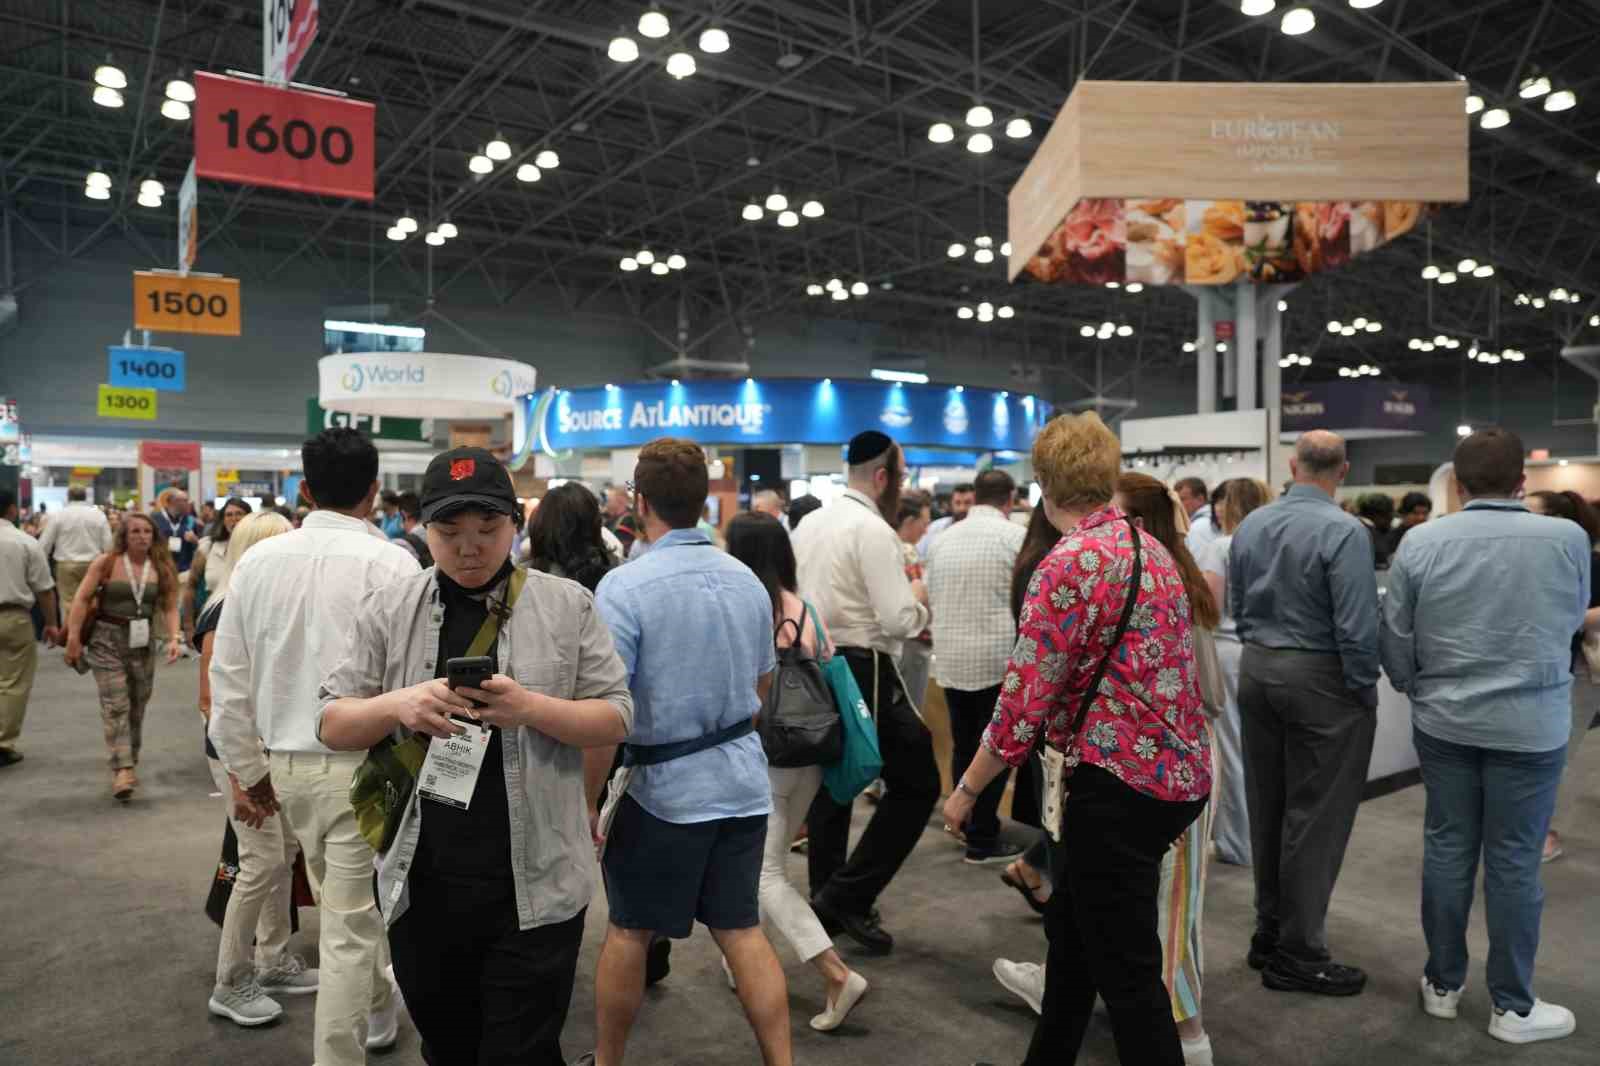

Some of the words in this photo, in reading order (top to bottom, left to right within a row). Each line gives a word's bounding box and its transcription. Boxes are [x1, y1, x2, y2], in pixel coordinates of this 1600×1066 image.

[218, 108, 354, 165] 1600
[147, 290, 228, 318] 1500
[118, 360, 176, 379] 1400
[366, 364, 425, 384] World
[105, 394, 150, 410] 1300
